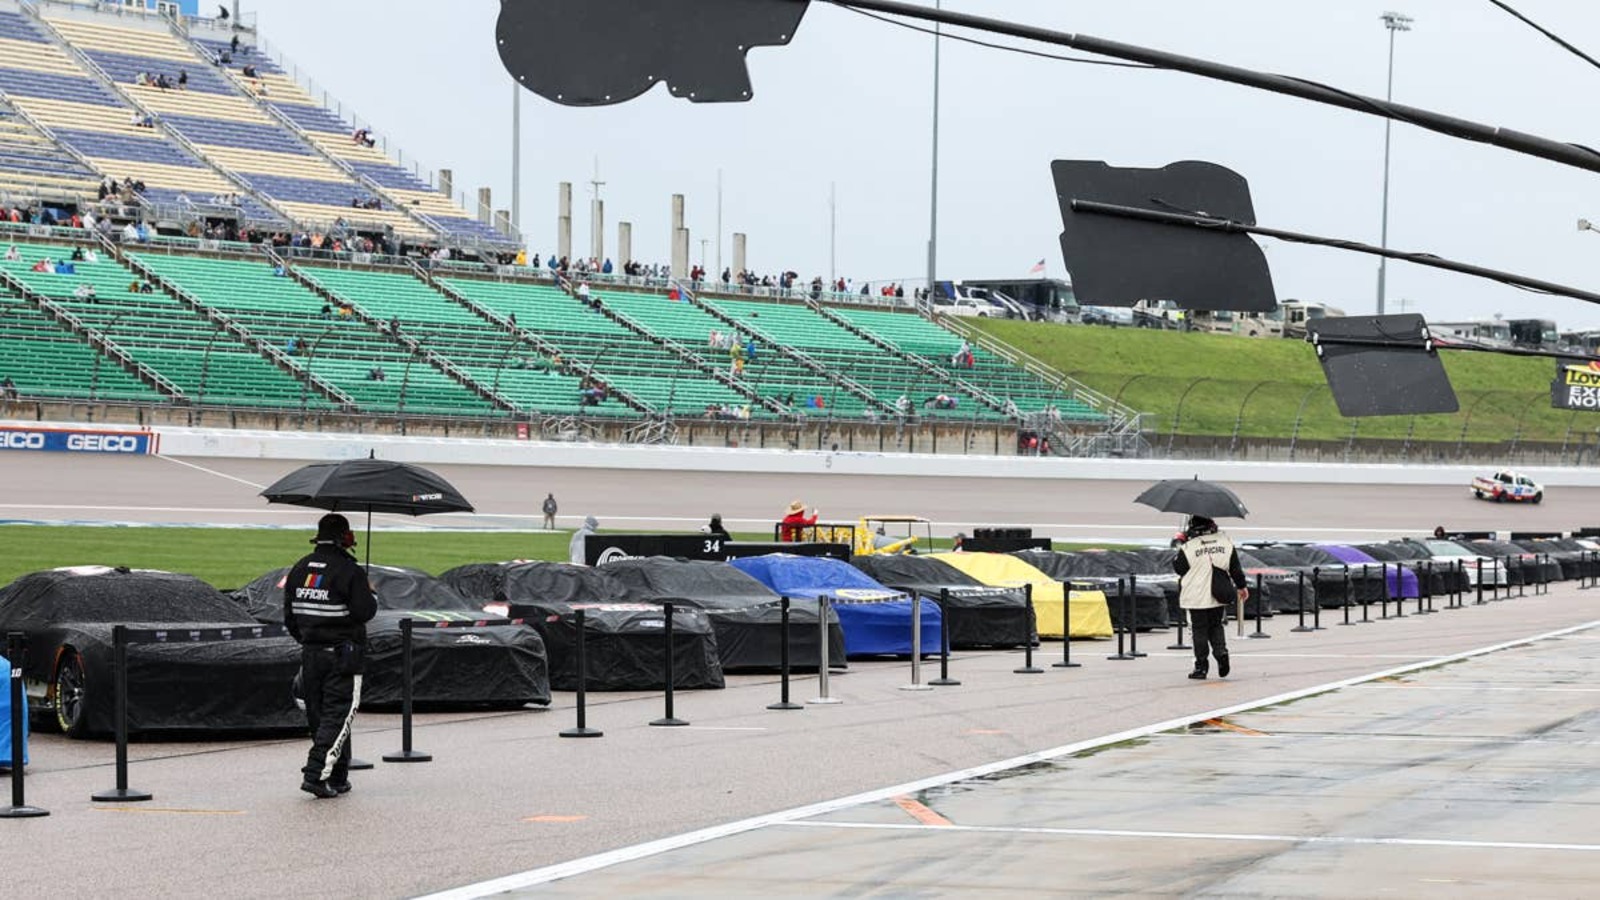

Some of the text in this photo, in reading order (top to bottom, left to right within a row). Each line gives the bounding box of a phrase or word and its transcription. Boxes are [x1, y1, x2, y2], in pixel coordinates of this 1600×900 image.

[1570, 386, 1600, 397] EX
[1568, 396, 1600, 407] NO
[67, 434, 137, 452] GEICO
[703, 540, 720, 552] 34
[1195, 546, 1224, 557] OFFICIAL
[295, 587, 330, 600] OFFICIAL
[11, 668, 22, 678] 10
